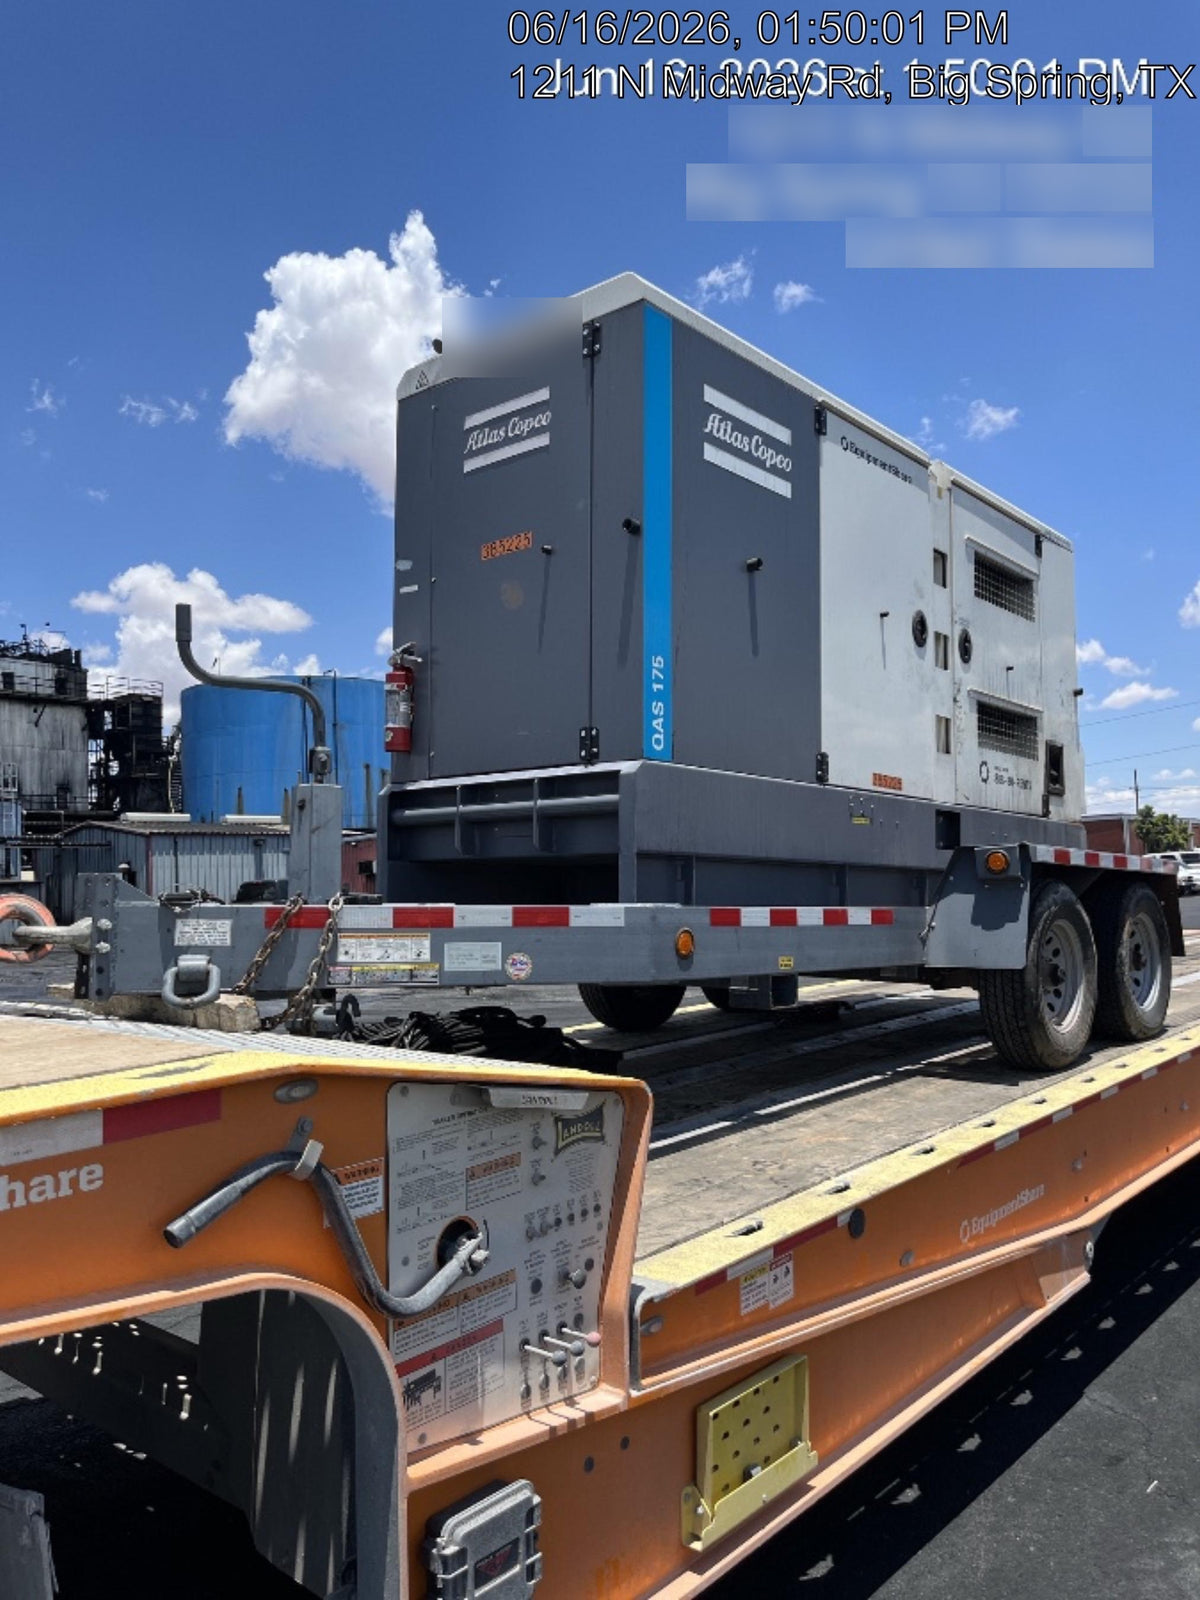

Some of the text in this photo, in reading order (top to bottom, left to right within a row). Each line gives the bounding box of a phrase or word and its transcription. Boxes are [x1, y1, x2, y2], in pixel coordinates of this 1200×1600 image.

[464, 410, 552, 454] Atlas Copco
[704, 413, 793, 473] Atlas Copco
[651, 655, 665, 751] QAS 175
[0, 1163, 104, 1212] hare
